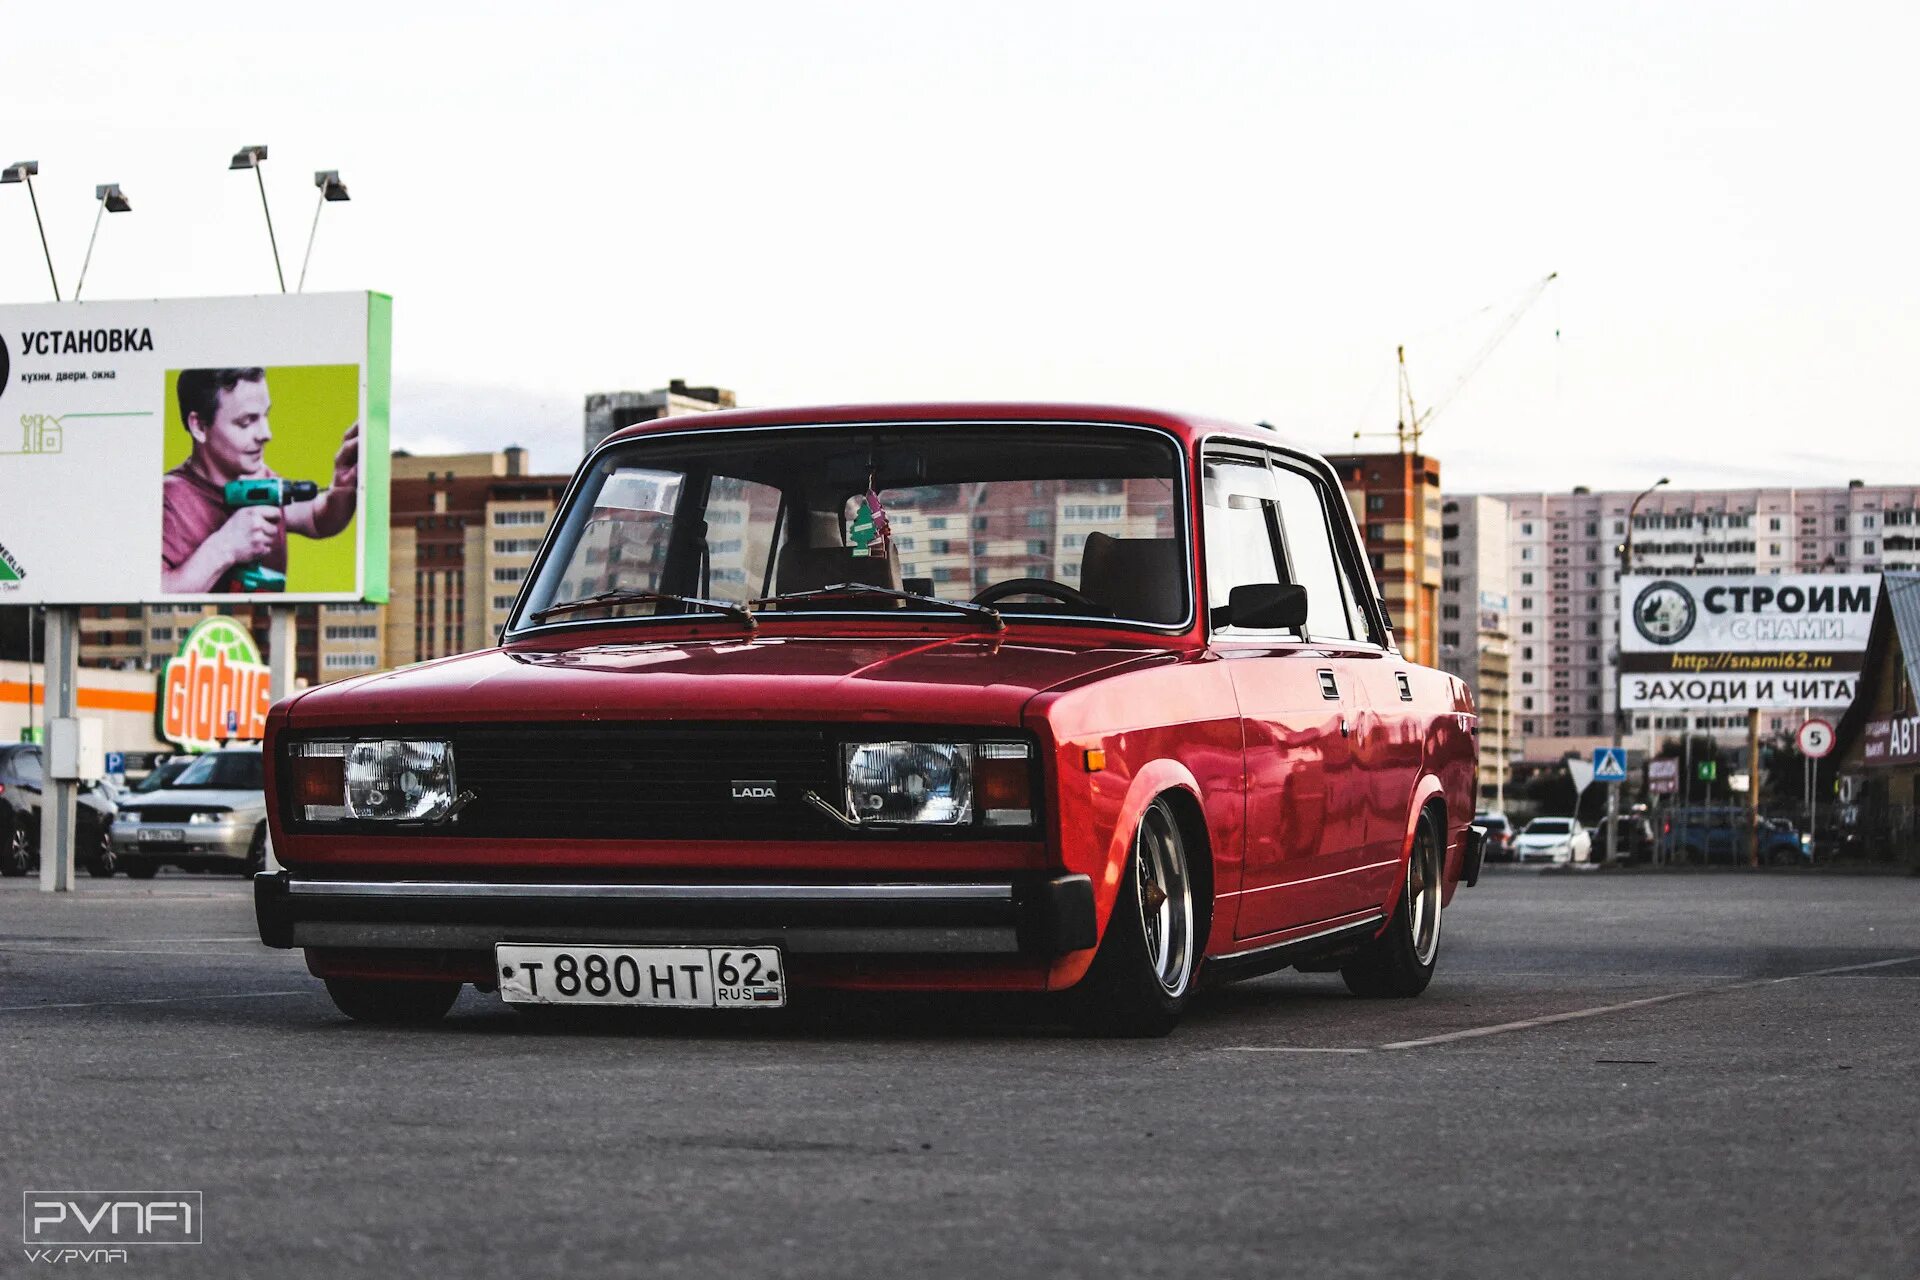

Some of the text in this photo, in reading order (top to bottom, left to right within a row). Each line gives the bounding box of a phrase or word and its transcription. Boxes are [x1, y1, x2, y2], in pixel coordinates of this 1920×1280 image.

[21, 328, 153, 355] УСТАНОВКА
[92, 370, 116, 379] окна
[1703, 586, 1871, 614] СТРОИМ
[1731, 618, 1844, 640] С НАМИ
[1671, 652, 1832, 672] http://snami62.ru
[1634, 680, 1857, 703] ЗАХОДИ И ЧИТА
[1811, 731, 1821, 746] 5
[109, 754, 120, 773] P
[732, 788, 775, 797] LADA
[718, 952, 764, 986] 62
[718, 988, 752, 1000] RUS
